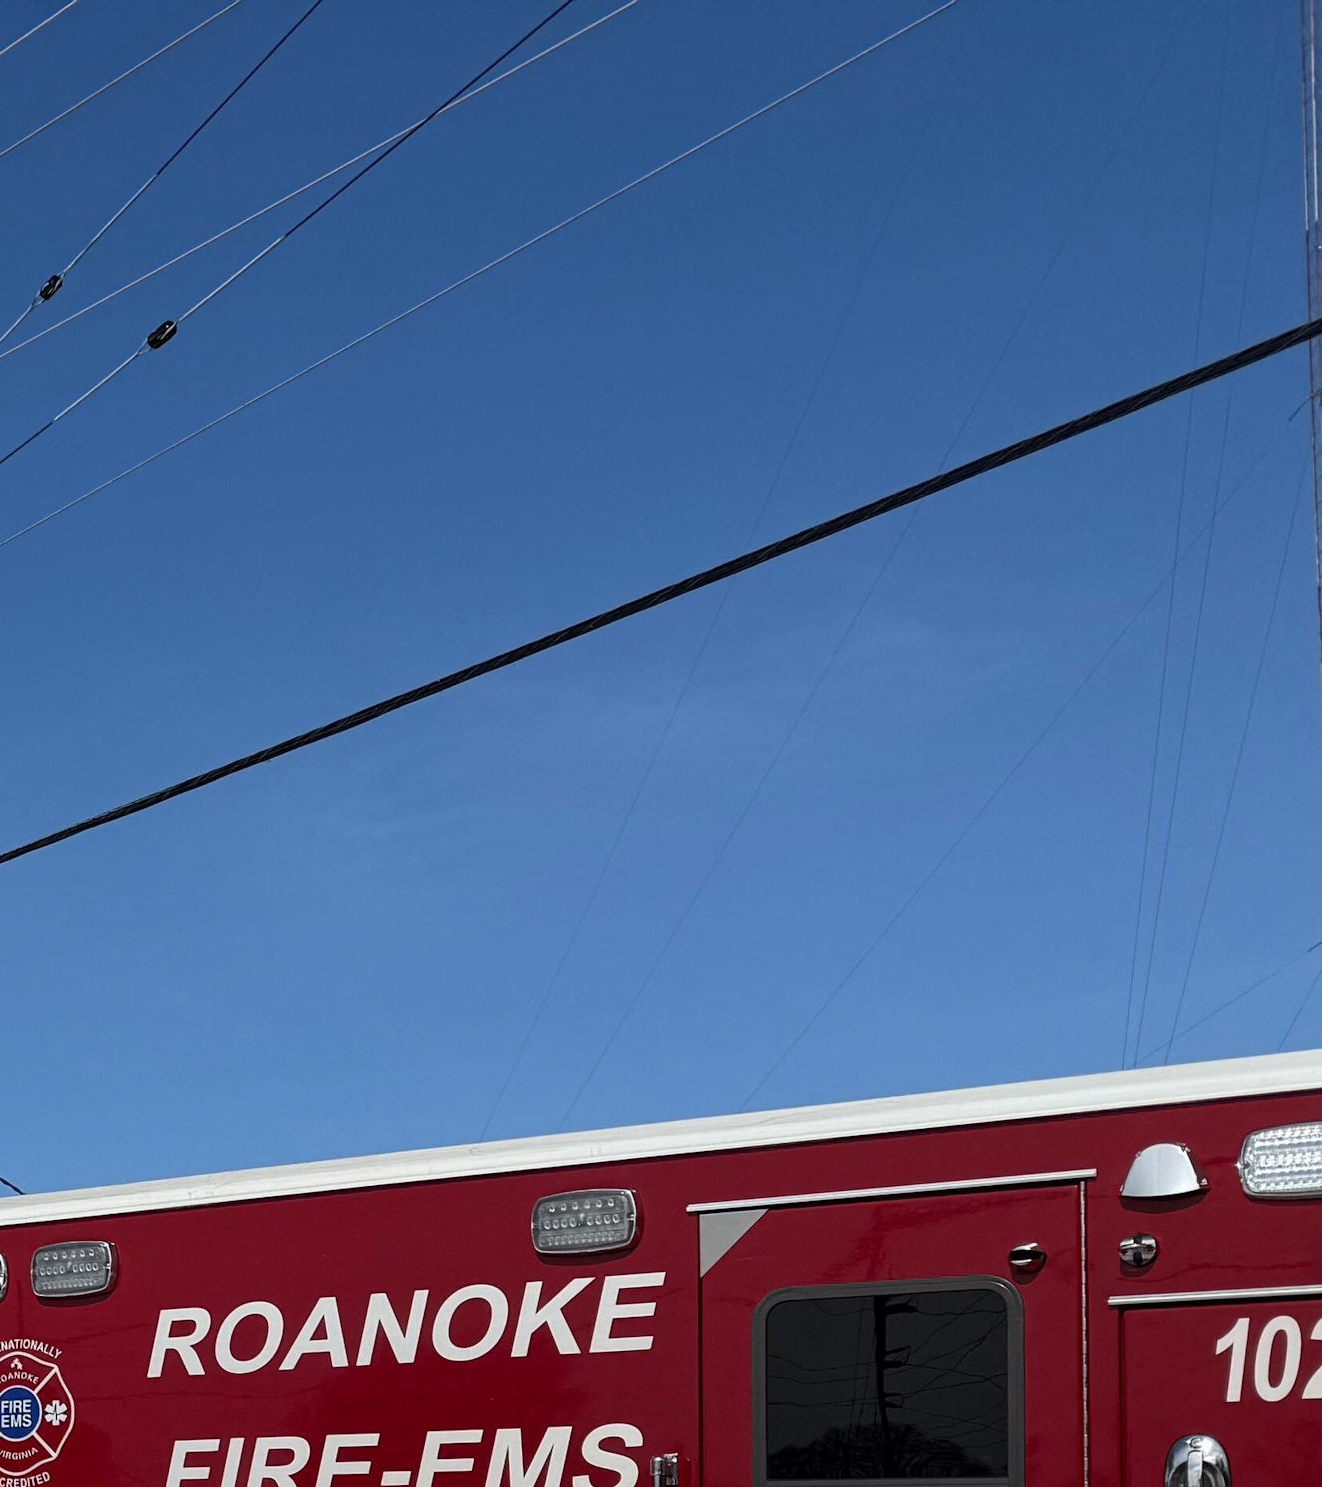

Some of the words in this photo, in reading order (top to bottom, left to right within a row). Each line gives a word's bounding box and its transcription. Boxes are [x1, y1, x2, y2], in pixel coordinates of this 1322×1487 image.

[147, 1271, 666, 1379] ROANOKE
[0, 1399, 32, 1413] FIRE
[0, 1414, 32, 1428] EMS
